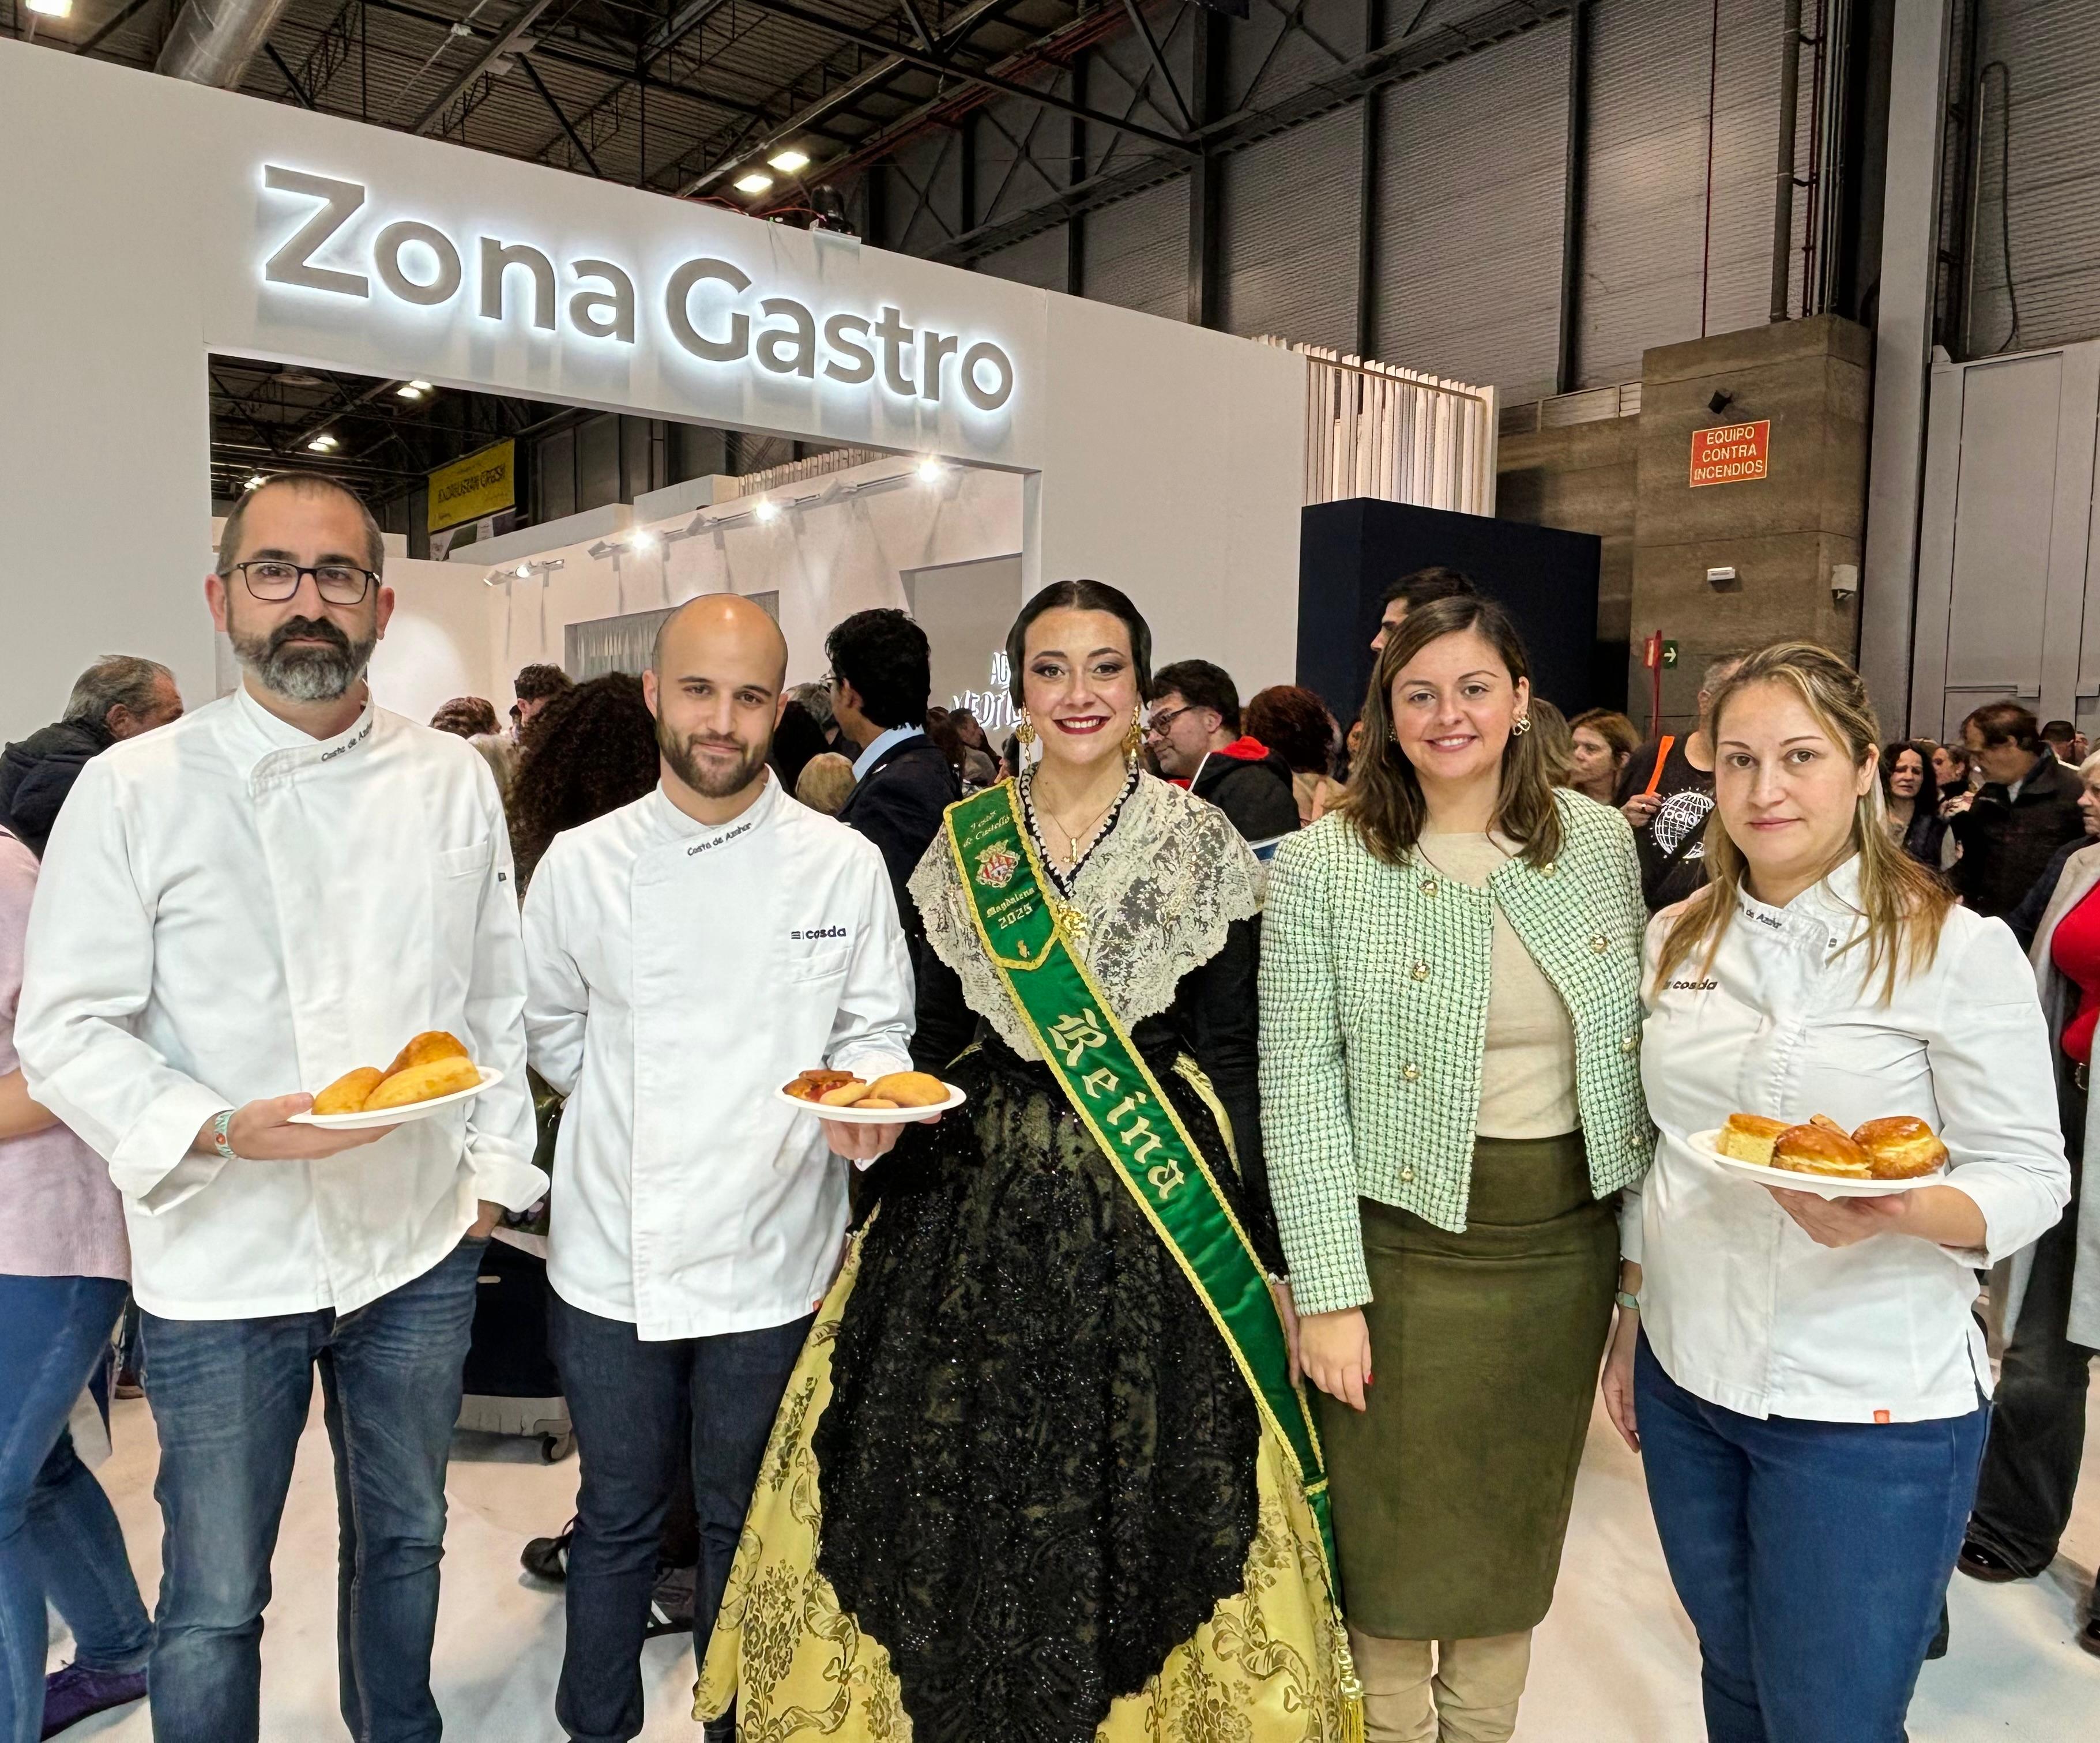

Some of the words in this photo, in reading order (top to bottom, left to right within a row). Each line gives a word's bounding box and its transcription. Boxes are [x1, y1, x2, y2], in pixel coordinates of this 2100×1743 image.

[264, 164, 635, 344] Zona
[665, 258, 1013, 412] Gastro
[1707, 426, 1755, 445] EQUIPO
[1702, 443, 1757, 462] CONTRA
[1694, 460, 1763, 480] INCENDIOS
[687, 842, 712, 856] Costa
[713, 837, 724, 846] de
[987, 887, 1035, 918] Magdalena
[998, 902, 1033, 929] 2025
[805, 925, 846, 939] cosda
[1047, 1008, 1185, 1199] Reina
